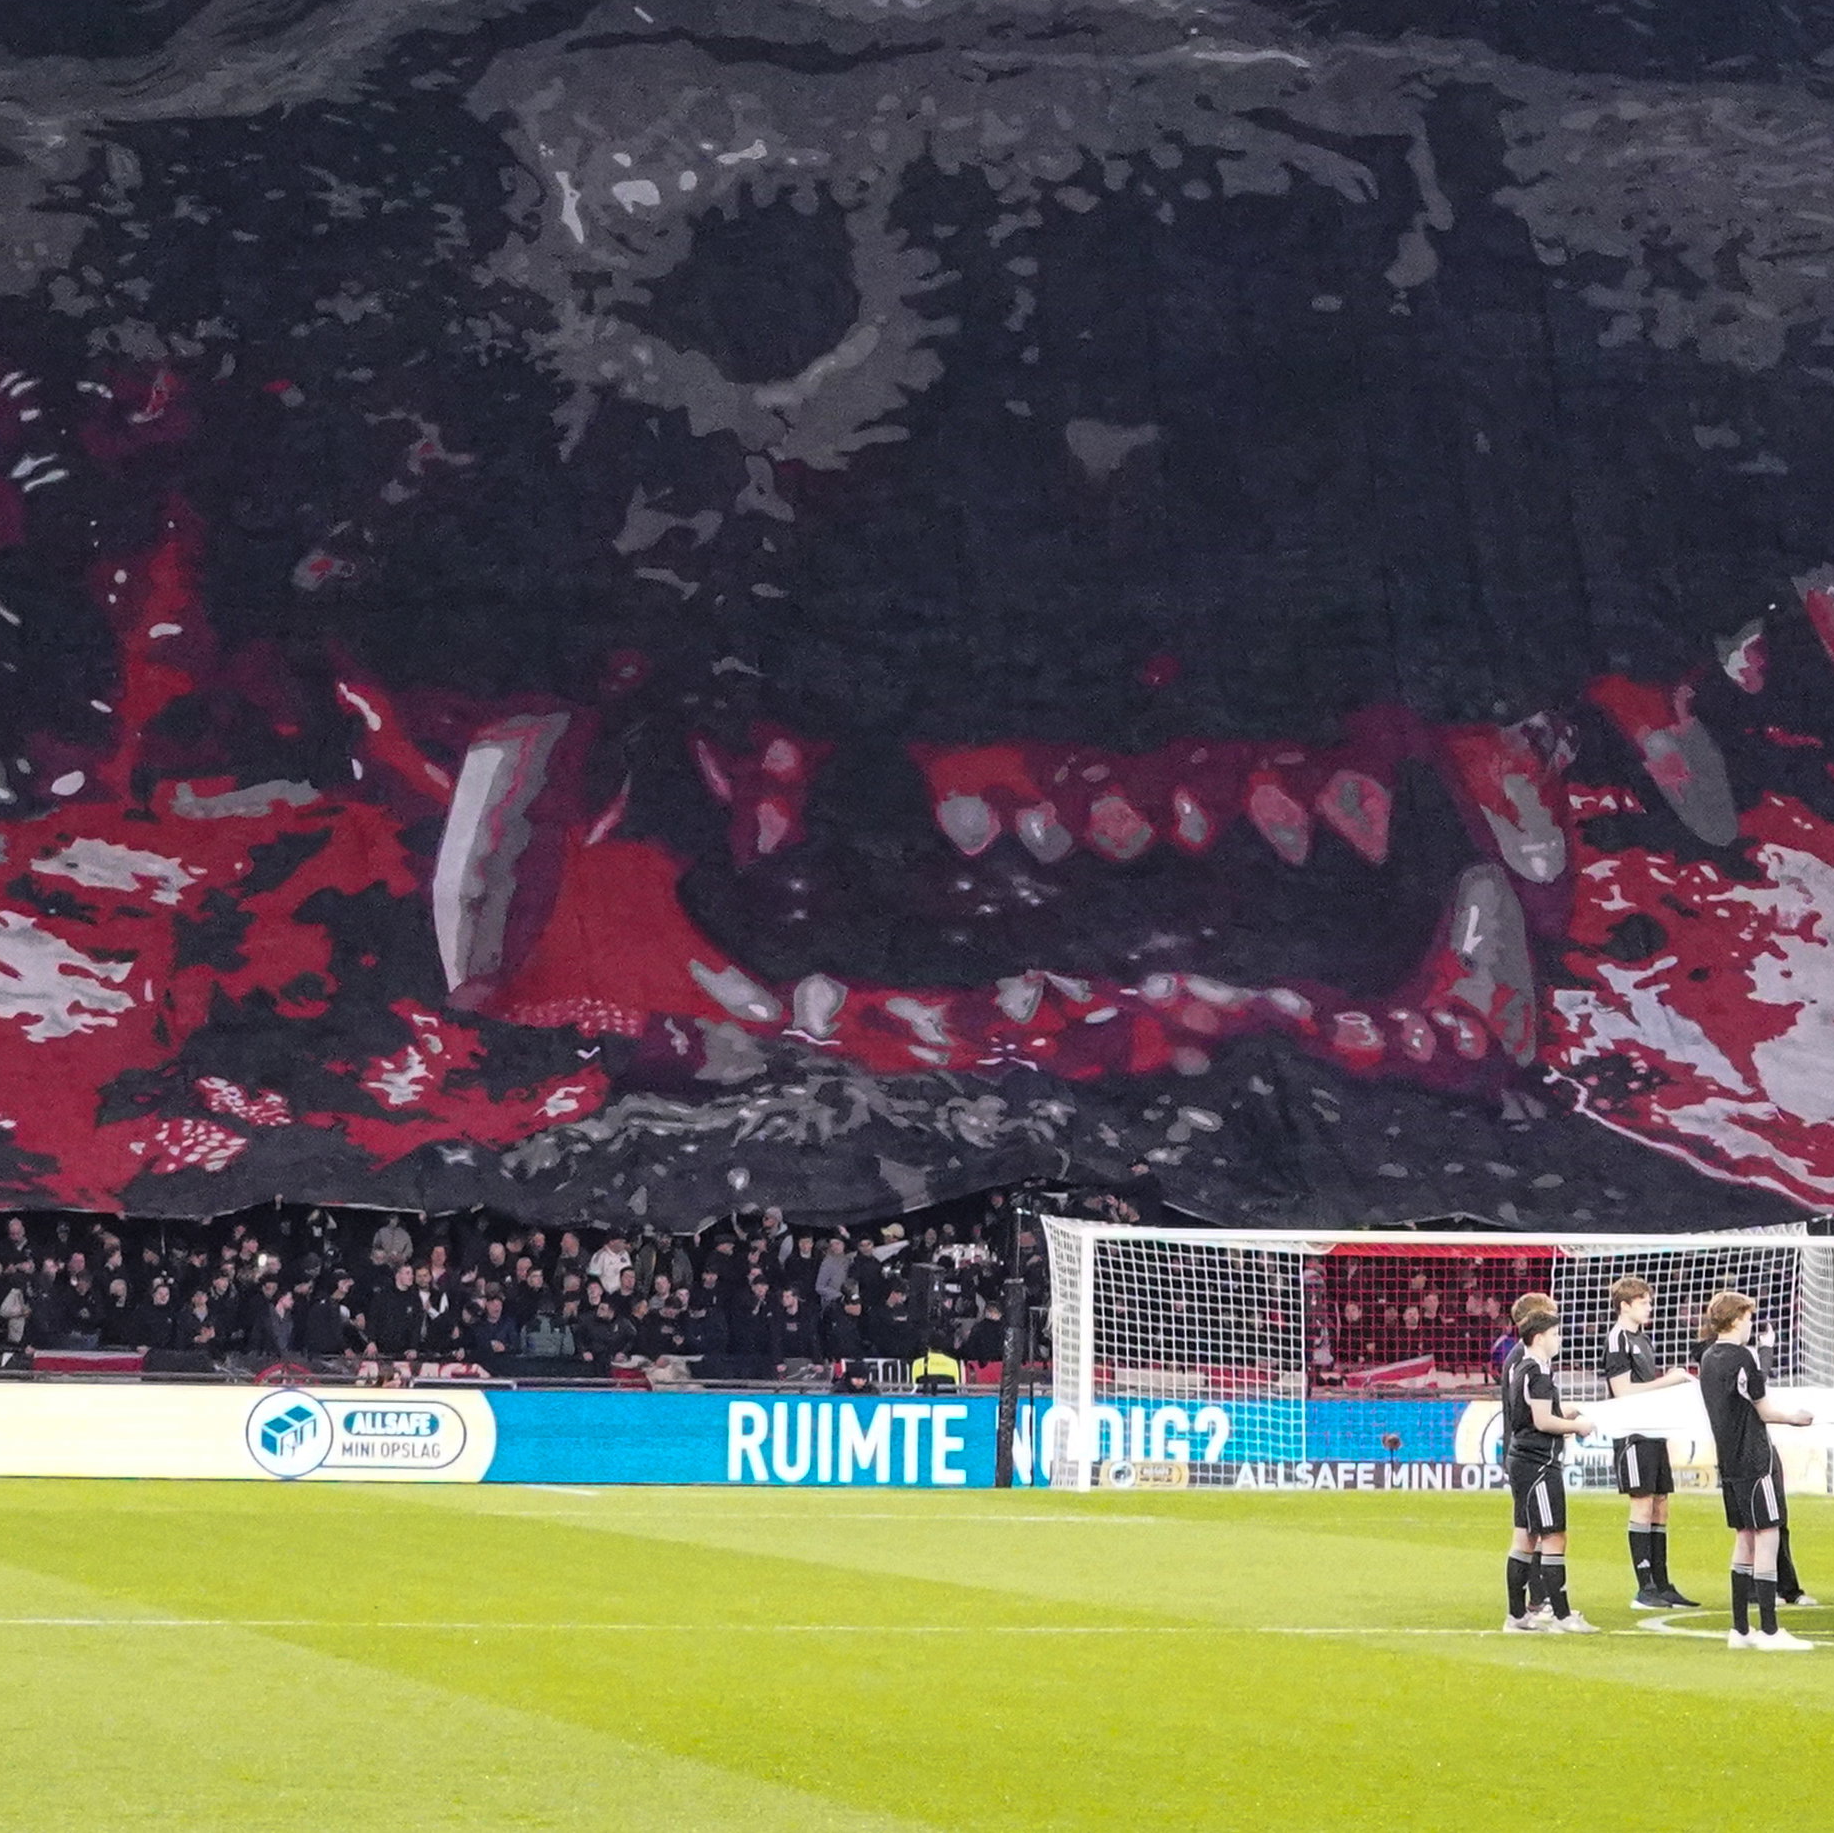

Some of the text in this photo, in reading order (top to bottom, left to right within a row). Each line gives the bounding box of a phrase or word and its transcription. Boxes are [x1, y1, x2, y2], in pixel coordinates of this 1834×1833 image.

[351, 1413, 432, 1436] ALLSAFE
[341, 1442, 441, 1459] MINI OPSLAG
[728, 1402, 967, 1486] RUIMTE
[1235, 1462, 1374, 1490] ALLSAFE
[1383, 1463, 1454, 1491] MINI
